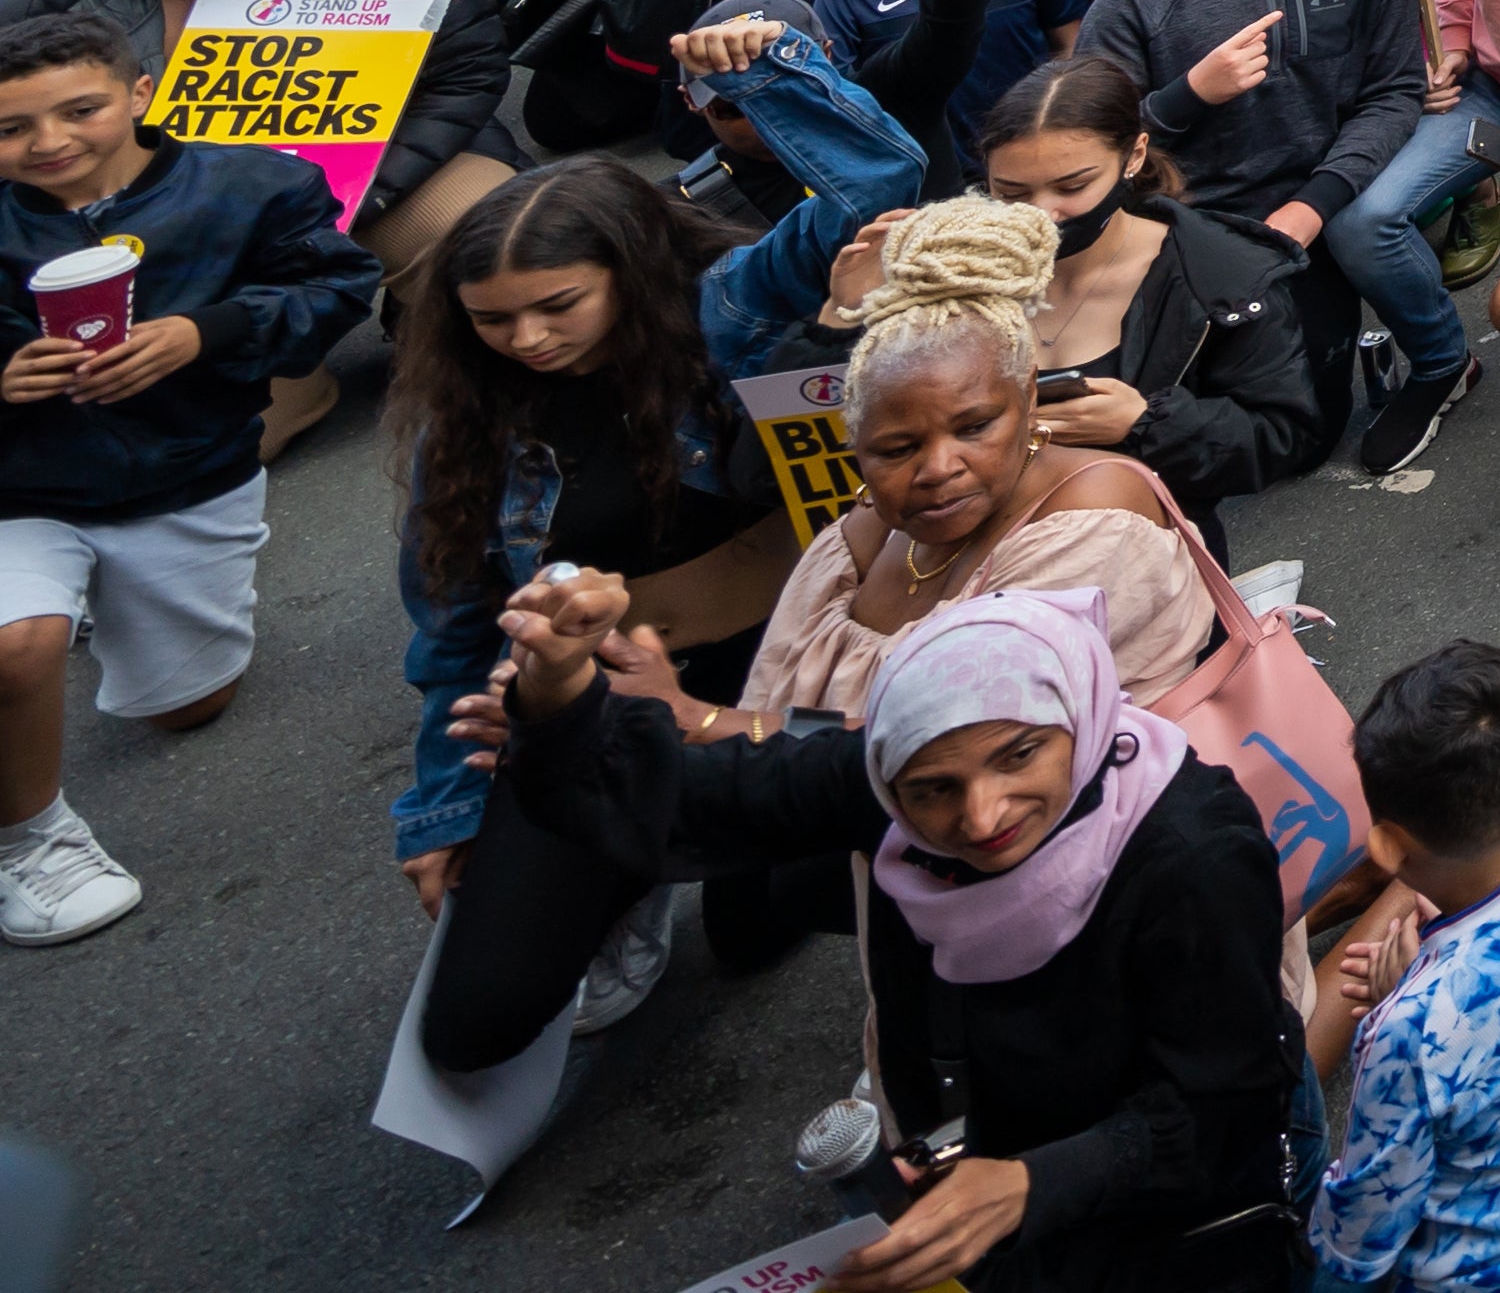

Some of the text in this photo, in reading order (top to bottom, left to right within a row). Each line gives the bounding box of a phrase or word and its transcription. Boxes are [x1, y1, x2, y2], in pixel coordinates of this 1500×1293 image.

[295, 11, 390, 26] TO RACISM
[362, 0, 387, 12] UP
[183, 34, 323, 68] STOP
[167, 70, 357, 102] RACIST
[158, 102, 383, 137] ATTACKS
